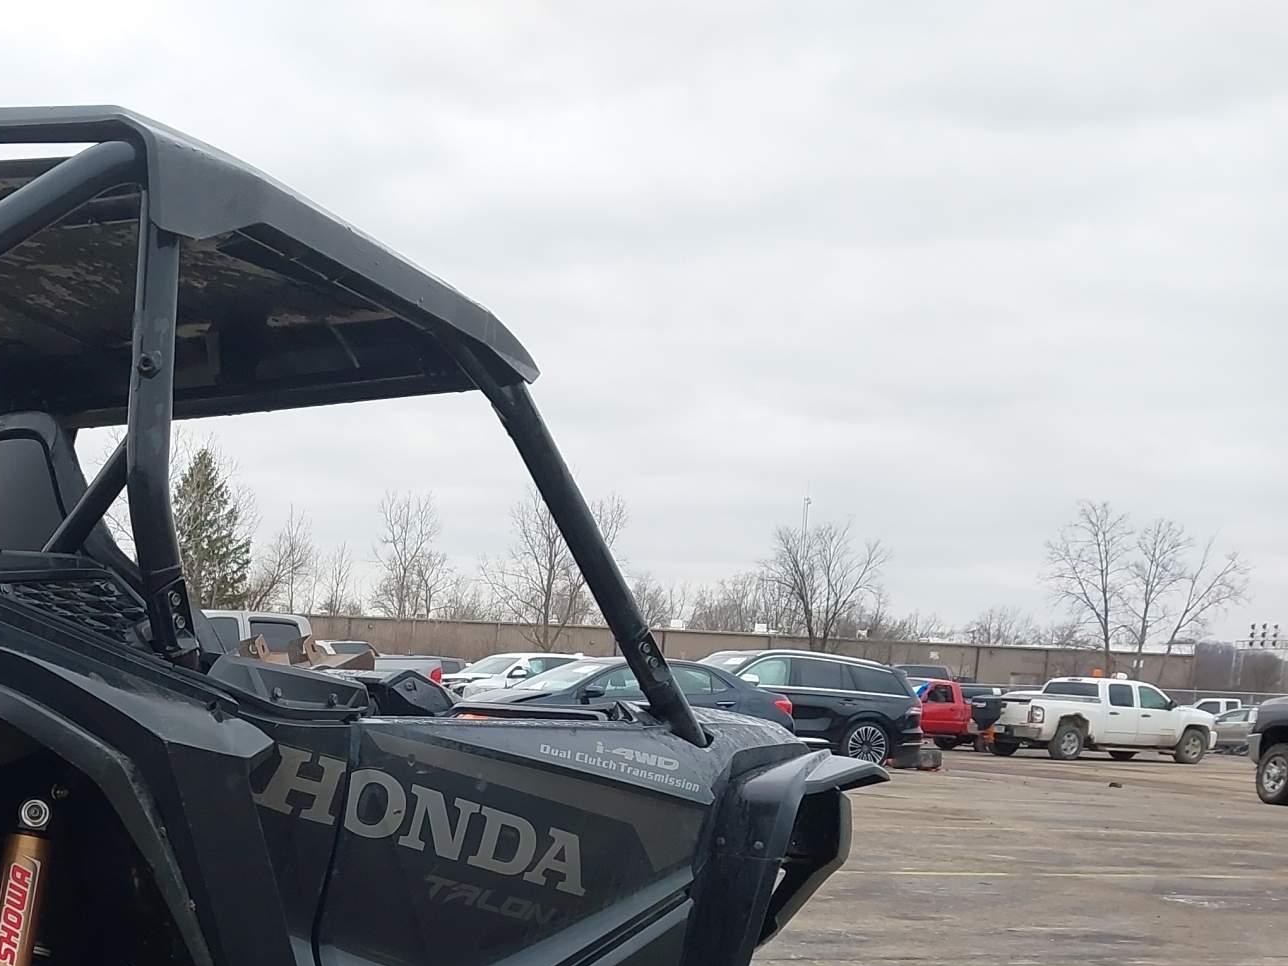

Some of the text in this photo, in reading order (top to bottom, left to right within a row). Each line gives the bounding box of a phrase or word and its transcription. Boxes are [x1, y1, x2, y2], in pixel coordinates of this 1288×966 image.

[540, 743, 701, 793] Dual Clutch Transmission
[595, 741, 680, 771] i-4WD
[250, 744, 586, 897] HONDA
[424, 874, 555, 924] TALON
